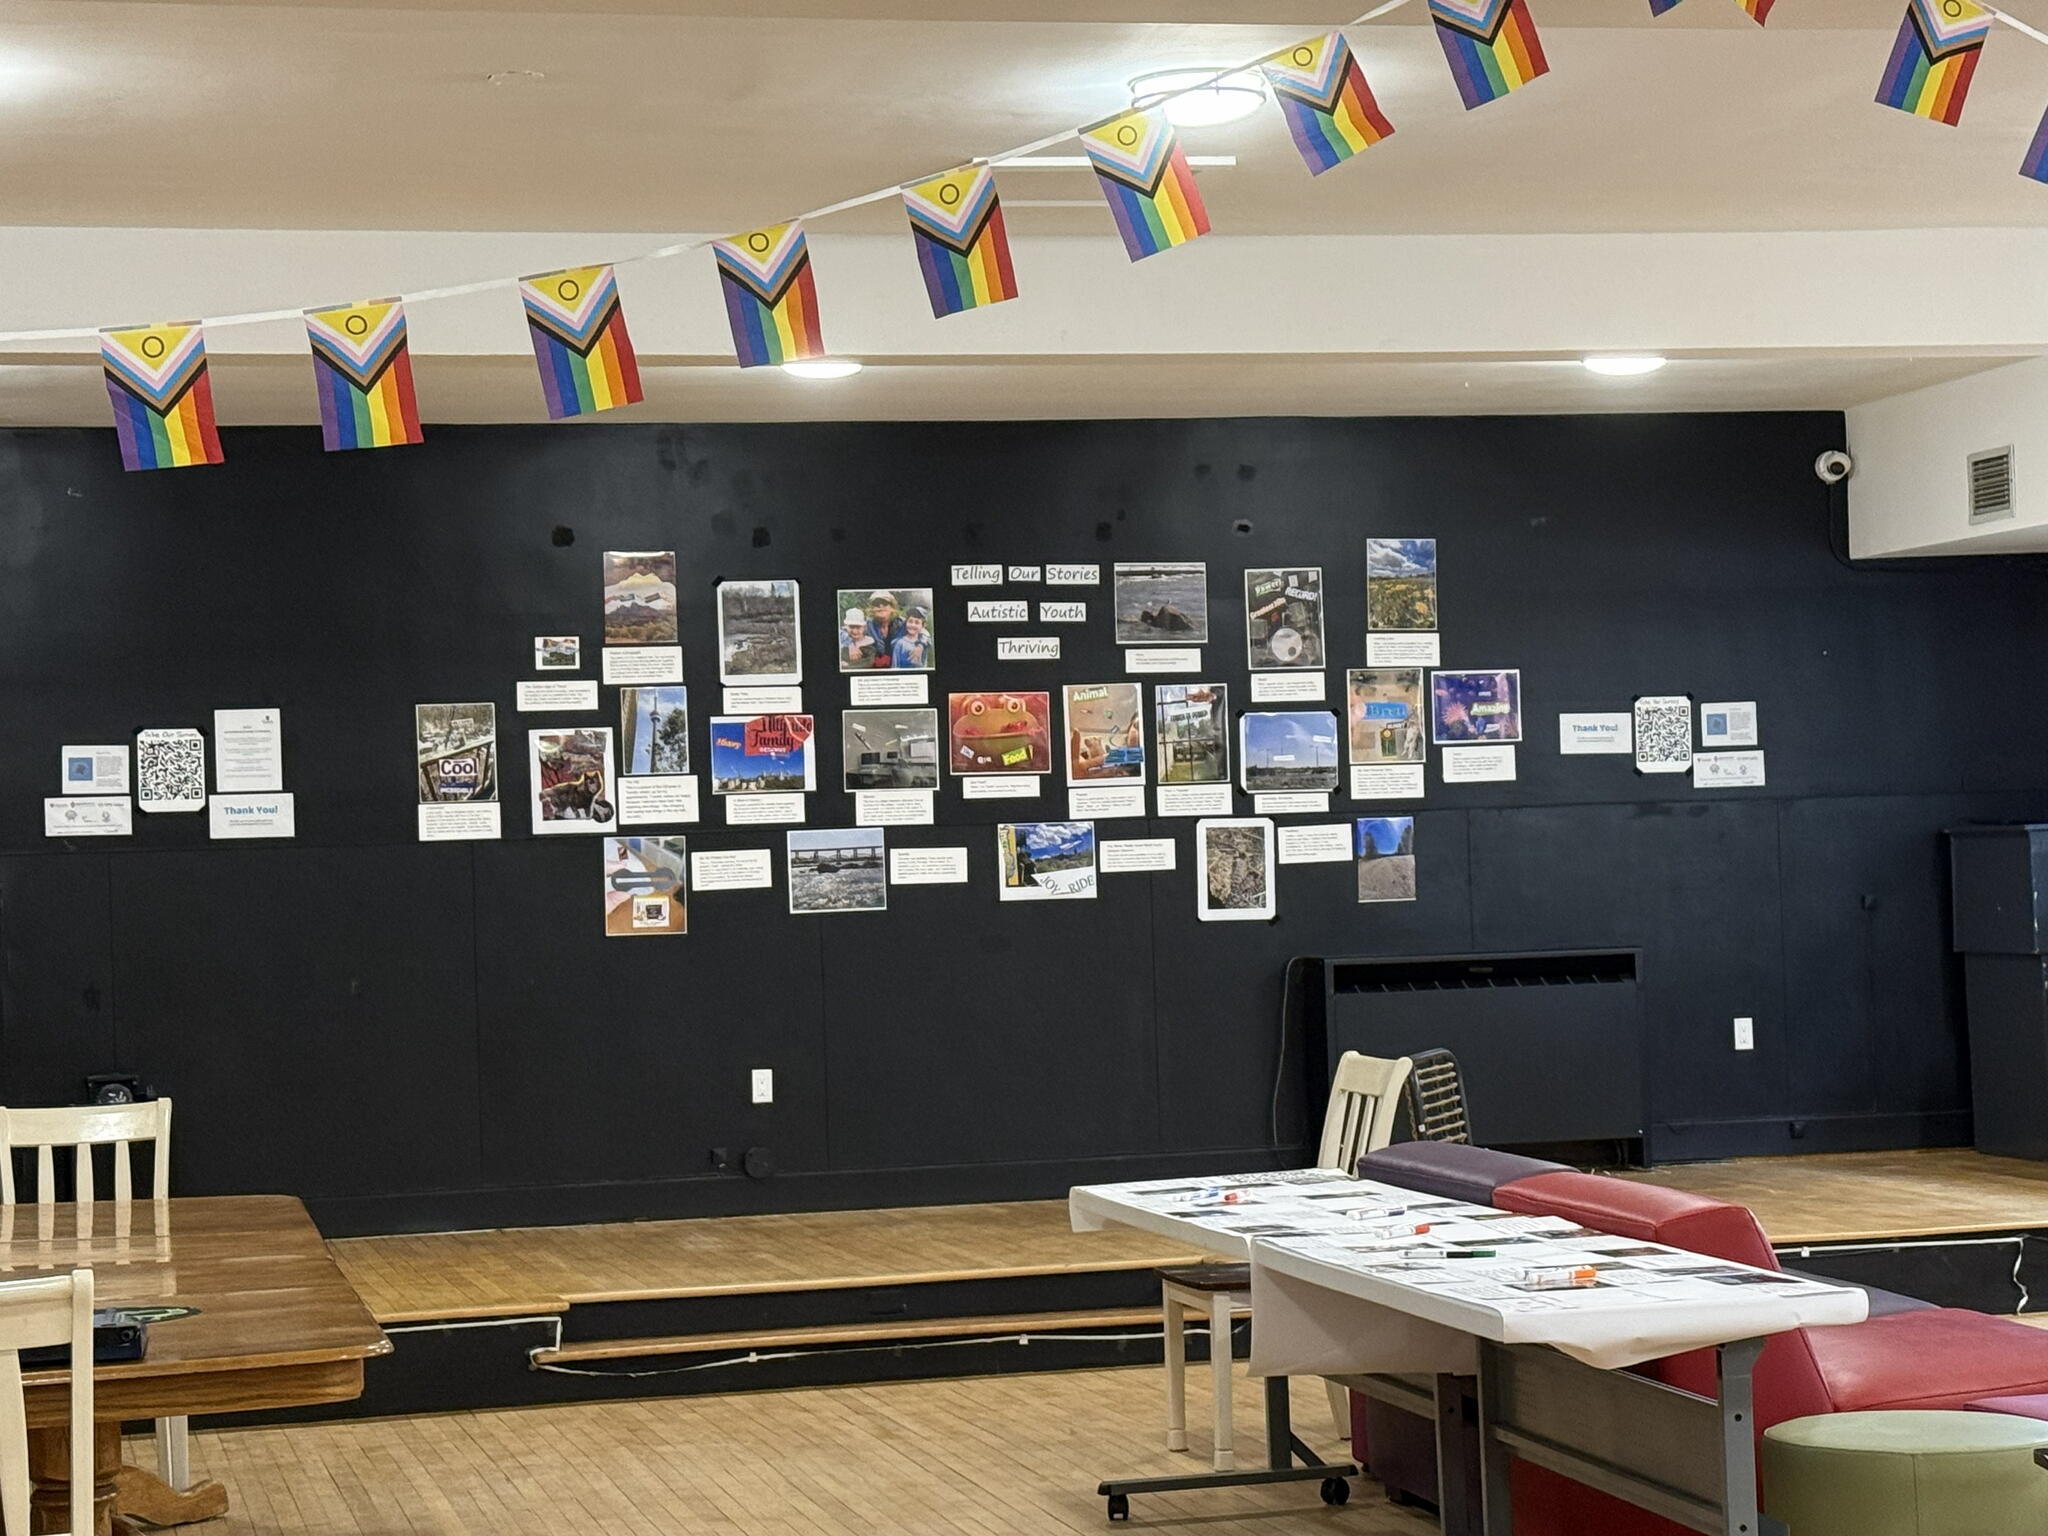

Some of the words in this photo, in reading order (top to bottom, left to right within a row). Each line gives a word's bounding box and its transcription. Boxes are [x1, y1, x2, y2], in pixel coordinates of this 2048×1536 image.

[953, 566, 1001, 582] Telling
[1010, 567, 1039, 580] Our
[1047, 567, 1098, 580] Stories
[969, 604, 1026, 619] Autistic
[1041, 606, 1084, 619] Youth
[999, 641, 1059, 657] Thriving
[1073, 687, 1108, 702] Animal
[1471, 702, 1511, 715] Amazing
[1572, 724, 1598, 732] Thank
[1599, 724, 1619, 732] You!
[751, 729, 793, 752] Family
[441, 759, 477, 776] Cool
[224, 805, 255, 815] Thank
[256, 805, 279, 815] You!
[1040, 875, 1061, 895] JOY
[1068, 874, 1095, 893] RIDE
